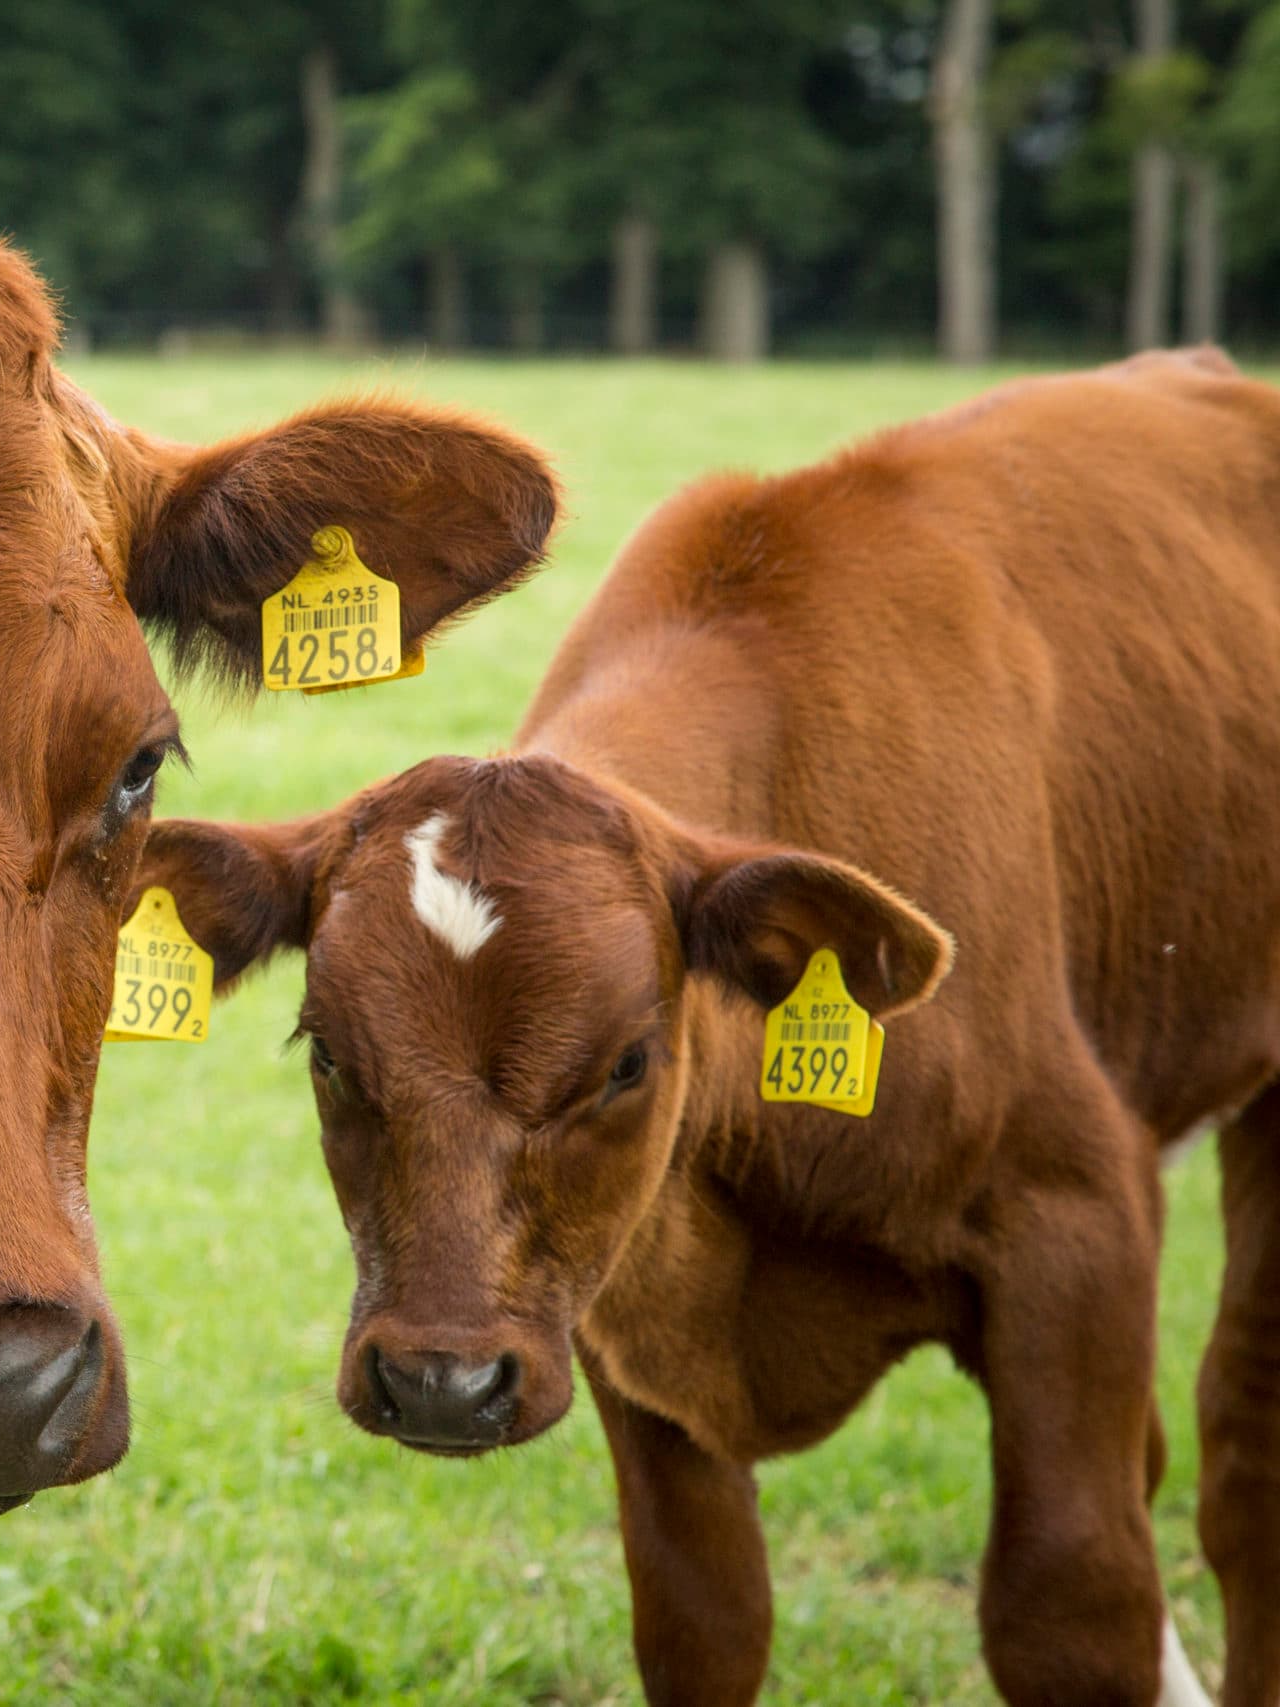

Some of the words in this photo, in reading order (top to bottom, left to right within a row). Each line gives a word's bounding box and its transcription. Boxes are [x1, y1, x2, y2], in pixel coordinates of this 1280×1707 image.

[282, 593, 311, 610] NL
[322, 585, 379, 605] 4935
[148, 941, 193, 961] 8977
[783, 1004, 803, 1020] NL
[810, 1004, 851, 1020] 8977
